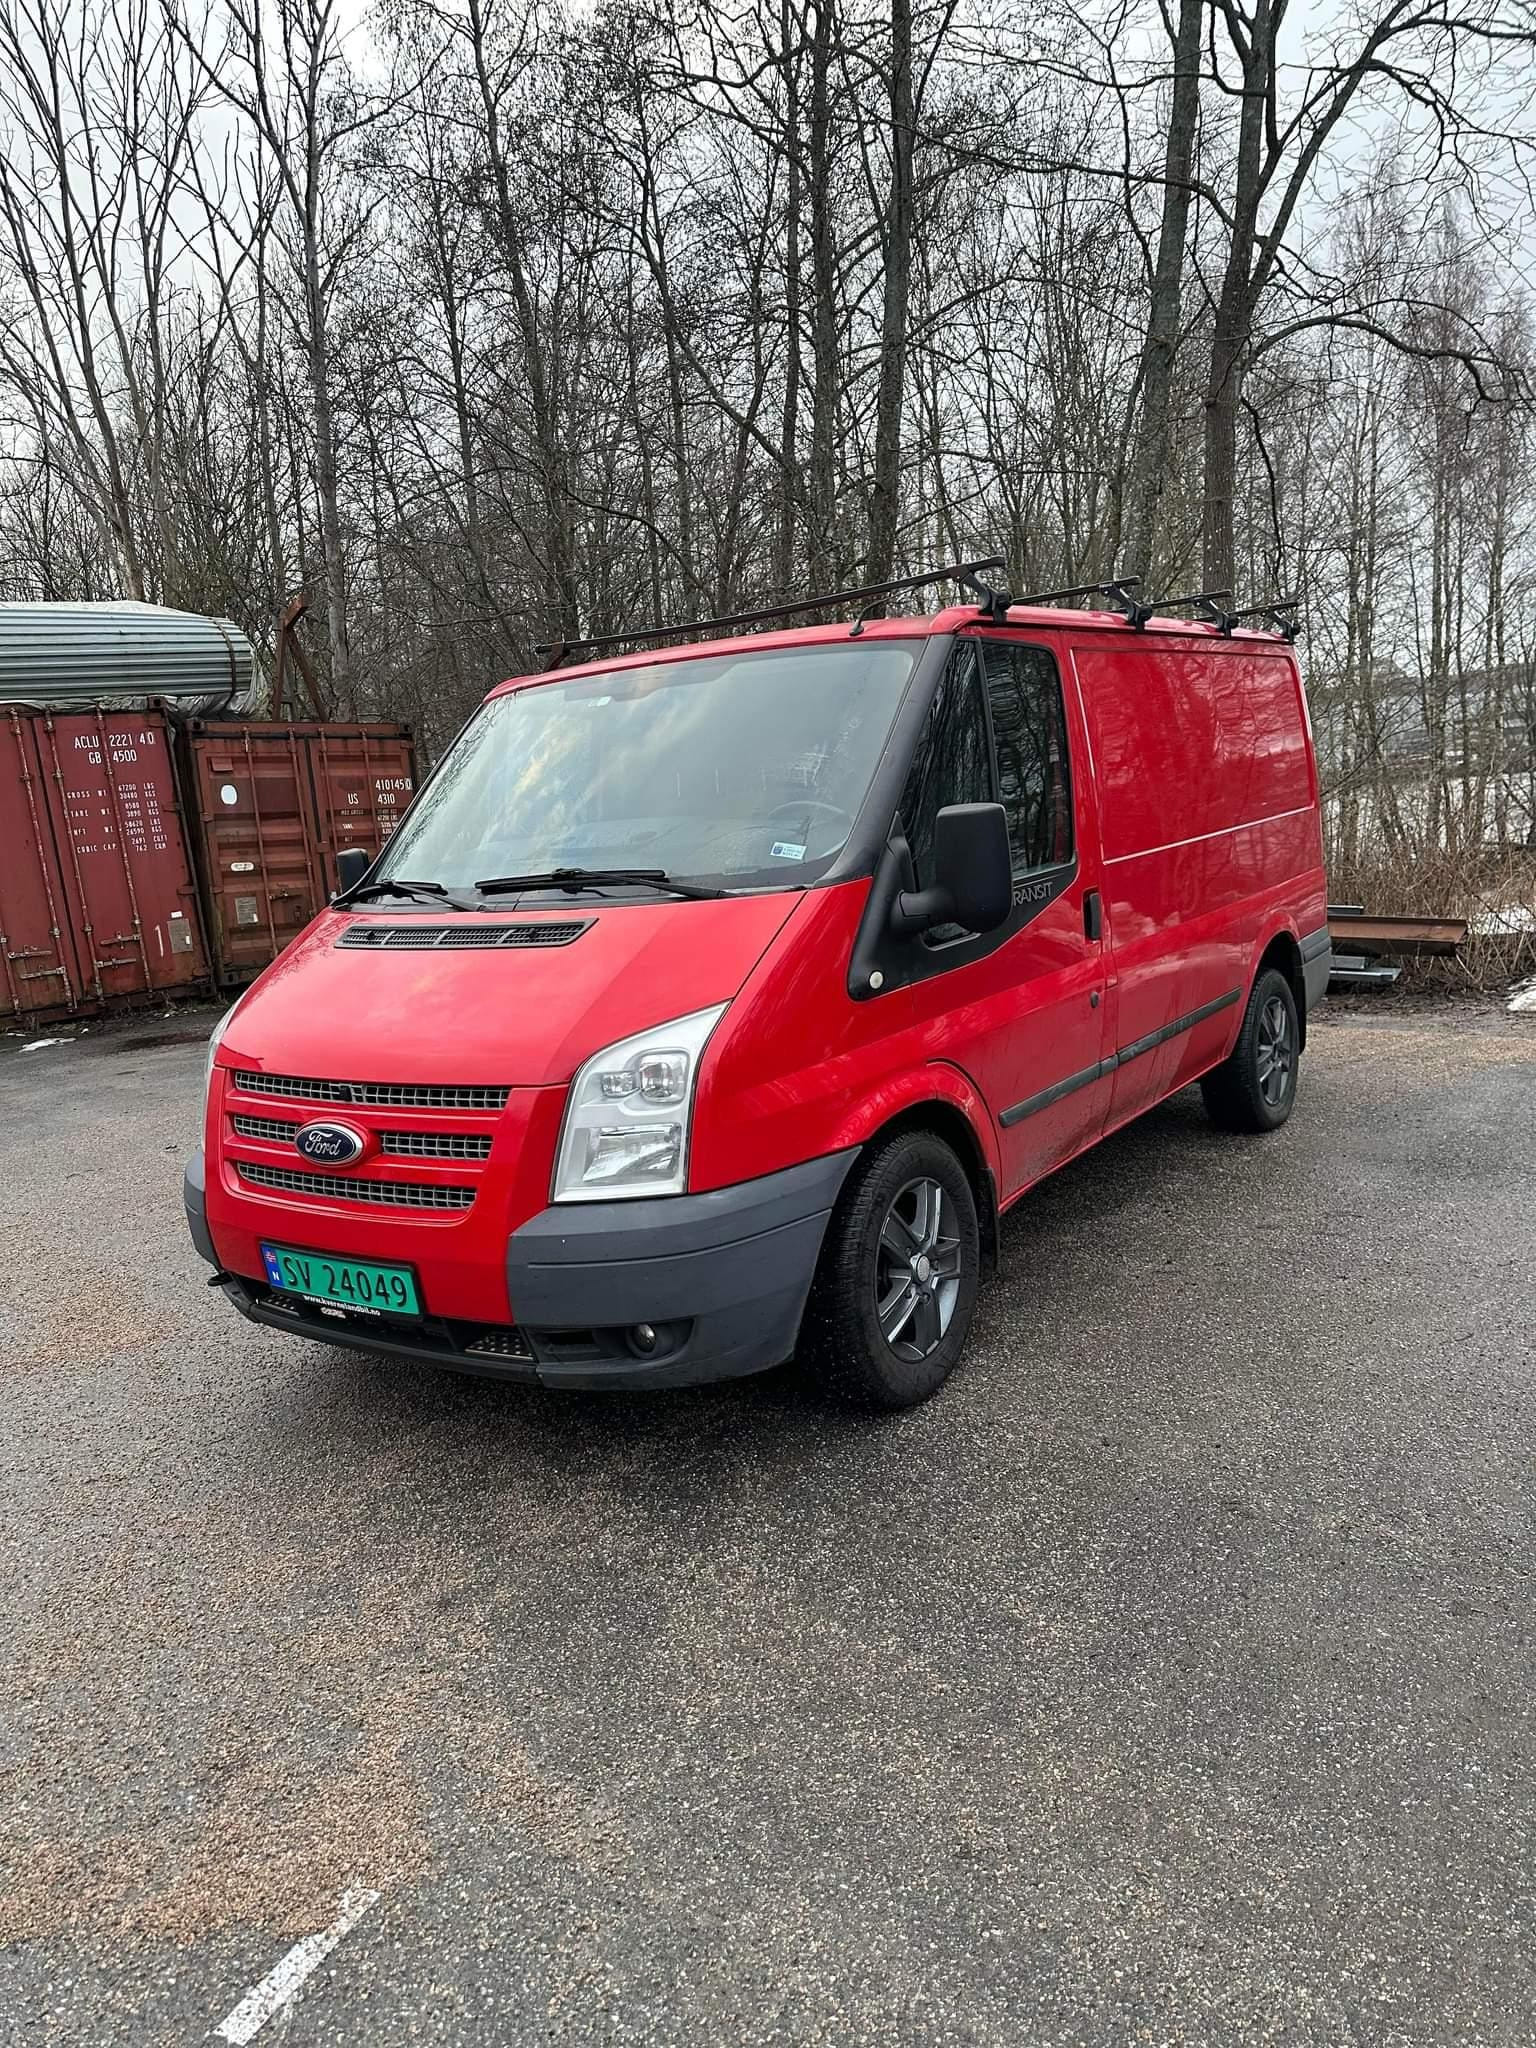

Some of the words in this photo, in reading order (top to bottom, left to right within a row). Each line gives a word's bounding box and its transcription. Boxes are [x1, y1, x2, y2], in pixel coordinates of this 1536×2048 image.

[74, 735, 100, 749] ACLU
[88, 751, 102, 764] GB
[112, 749, 137, 763] 4500
[66, 791, 90, 799] GROSS
[143, 782, 155, 790] LBS
[347, 793, 359, 805] US
[377, 793, 396, 805] 4310
[1012, 881, 1053, 906] RANSIT
[304, 1130, 343, 1156] Ford
[272, 1271, 280, 1281] N
[283, 1256, 311, 1290] SV
[322, 1264, 408, 1307] 24049
